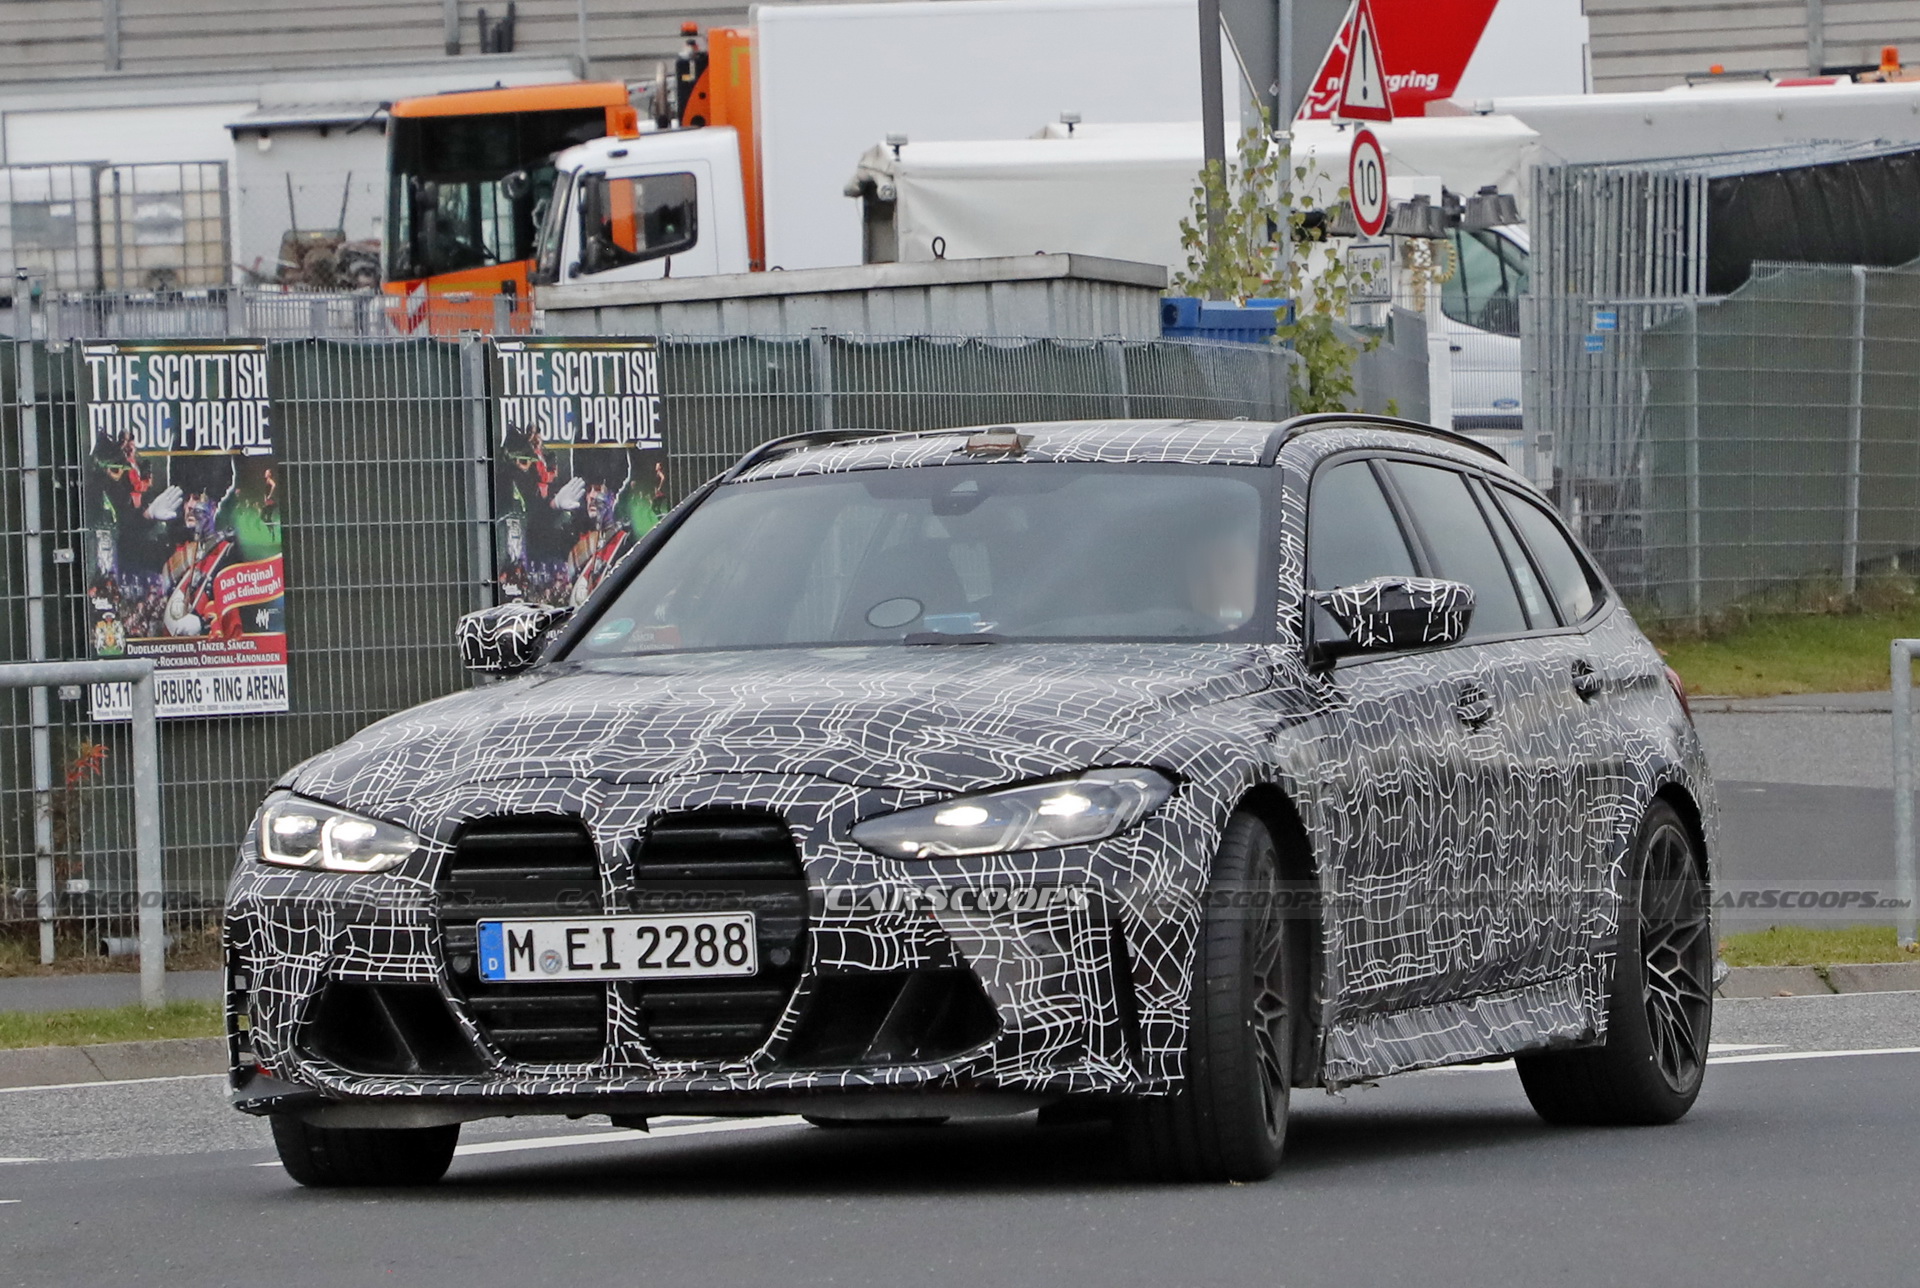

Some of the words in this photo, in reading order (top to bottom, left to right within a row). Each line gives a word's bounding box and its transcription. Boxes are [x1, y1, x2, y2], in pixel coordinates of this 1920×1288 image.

[1358, 158, 1378, 207] 10
[84, 355, 141, 401] THE
[148, 353, 270, 401] SCOTTISH
[497, 351, 545, 396] THE
[551, 351, 660, 396] SCOTTISH
[87, 402, 172, 455] MUSIC
[180, 400, 272, 451] PARADE
[499, 397, 575, 447] MUSIC
[580, 396, 662, 445] PARADE
[220, 577, 235, 590] Das
[236, 564, 274, 585] Original
[222, 591, 236, 604] aus
[237, 577, 282, 598] Edinburgh!
[154, 678, 203, 705] ÜRBURG
[213, 677, 243, 702] RING
[246, 675, 286, 700] ARENA
[488, 958, 498, 971] D
[508, 929, 535, 972] M
[566, 927, 620, 971] EI
[637, 922, 748, 969] 2288
